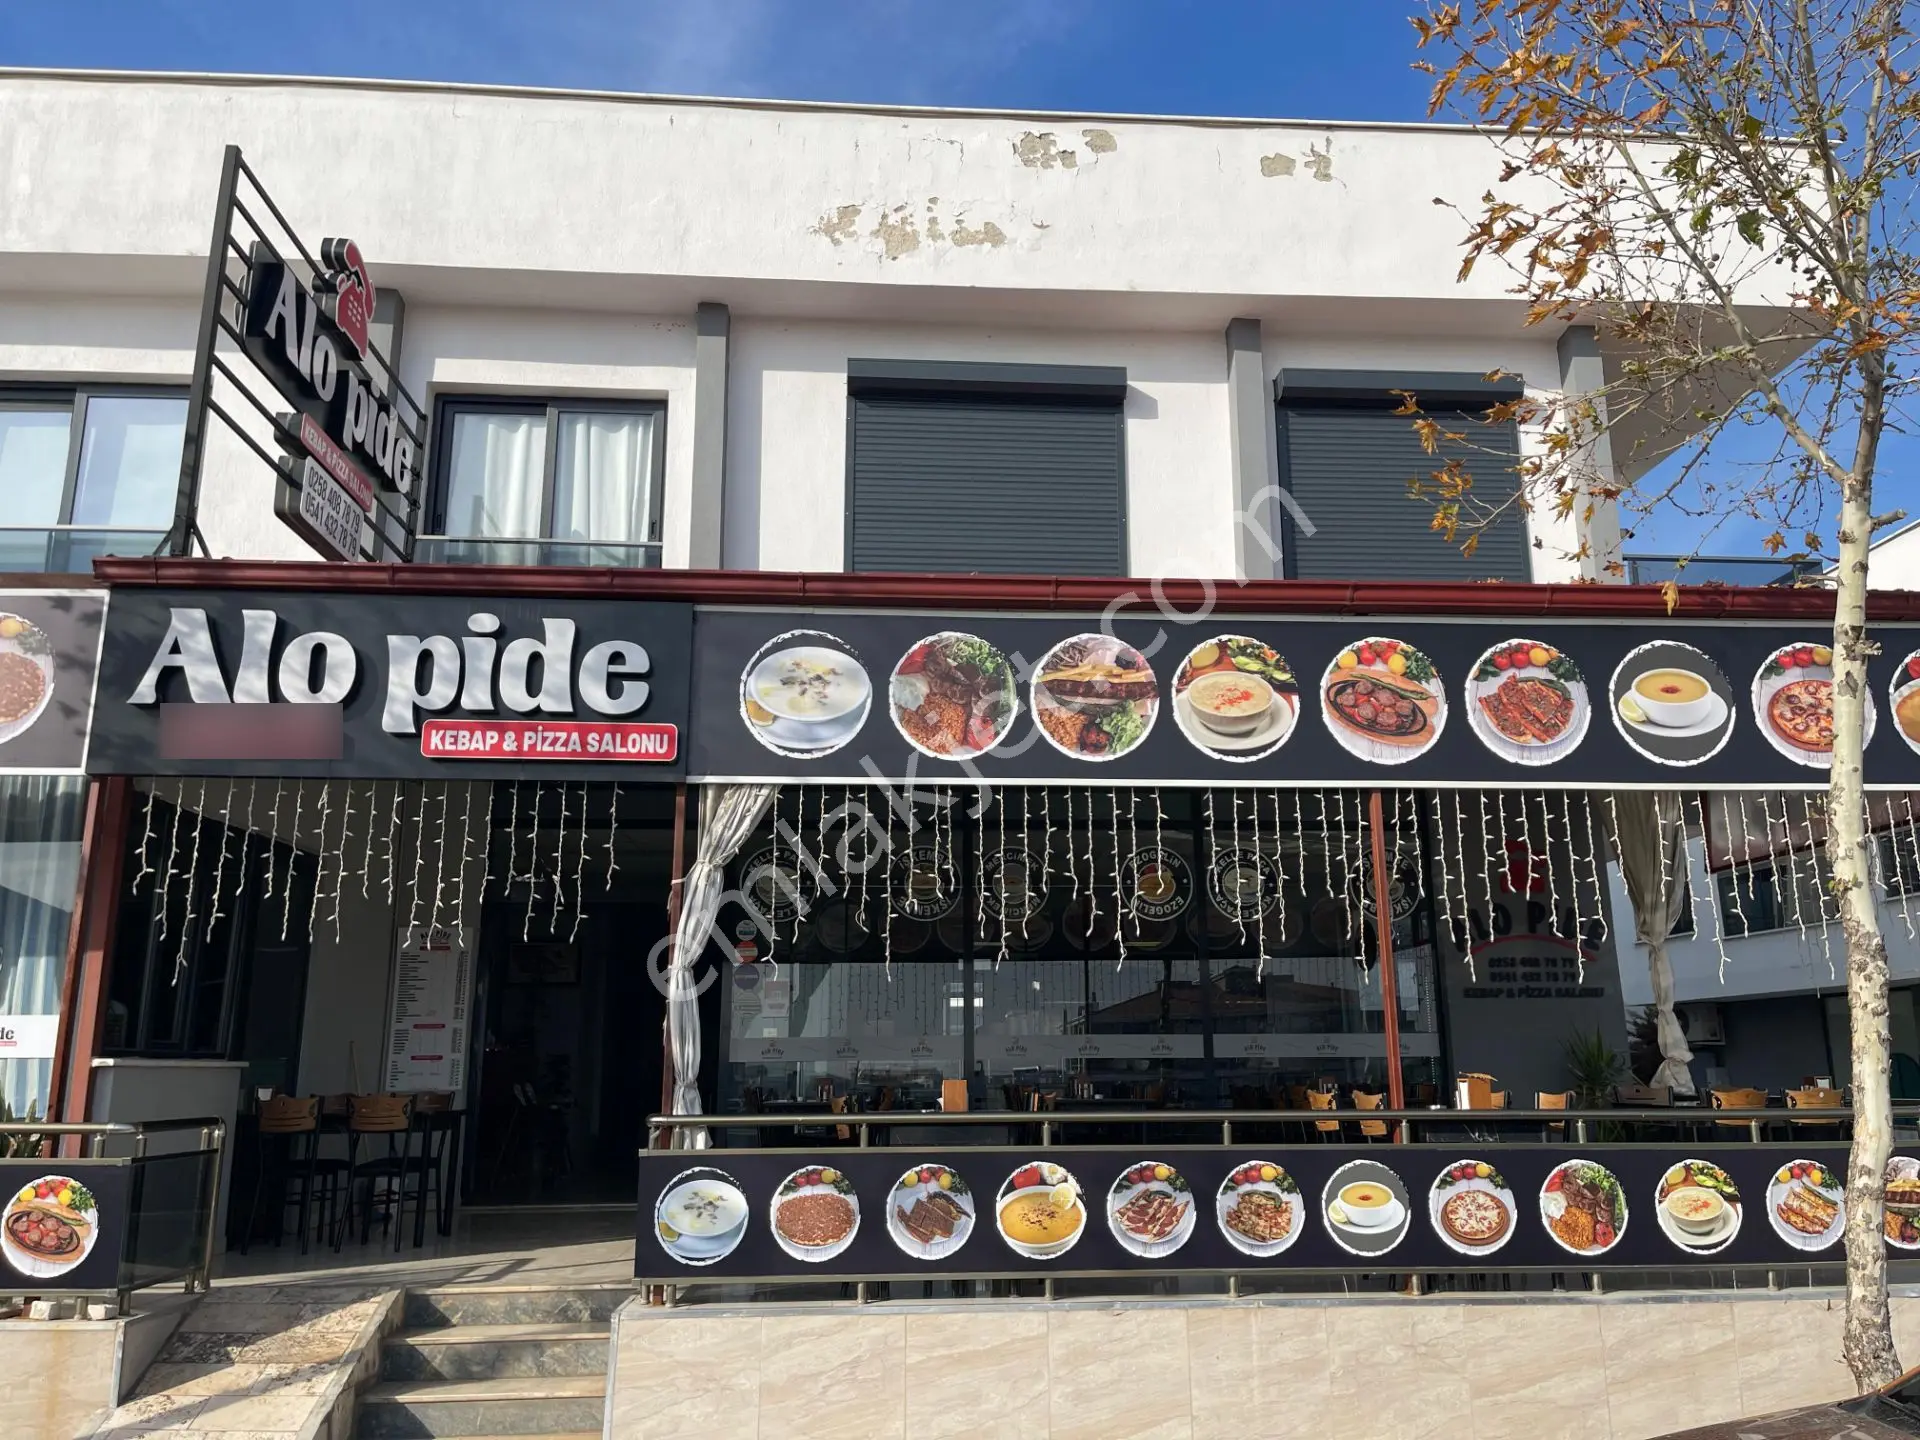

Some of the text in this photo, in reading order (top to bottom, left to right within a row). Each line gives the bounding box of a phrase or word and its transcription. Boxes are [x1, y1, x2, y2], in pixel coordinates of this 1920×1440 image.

[264, 263, 414, 494] Alo pide
[305, 491, 357, 557] 0541 432 78 79
[308, 466, 360, 534] 0258 408 78 79
[126, 607, 357, 705] Alo
[381, 612, 651, 734] pide
[431, 729, 498, 751] KEBAP
[503, 731, 518, 751] &
[587, 732, 669, 754] SALONU
